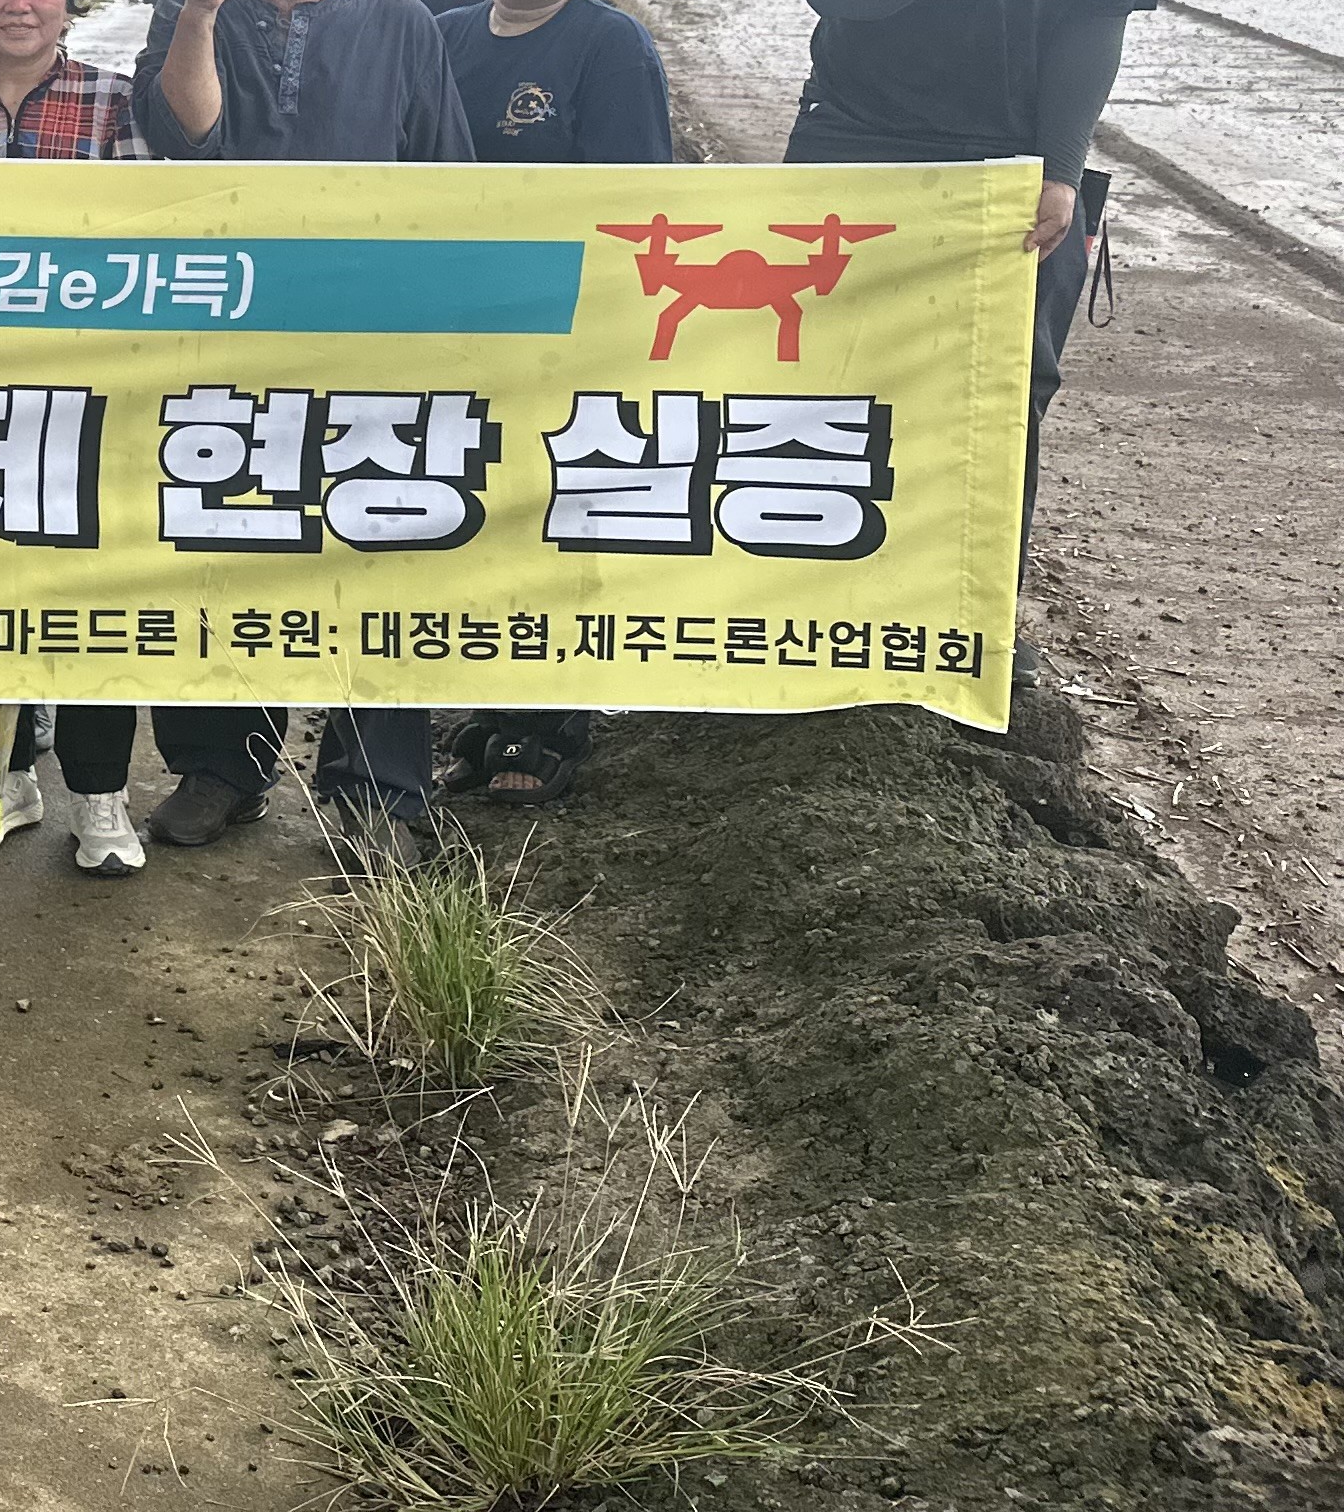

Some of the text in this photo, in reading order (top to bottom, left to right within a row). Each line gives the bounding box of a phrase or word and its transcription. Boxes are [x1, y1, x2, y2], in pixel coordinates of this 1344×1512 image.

[158, 384, 502, 553] 현장
[541, 390, 894, 560] 실증
[231, 609, 337, 658] 후원:
